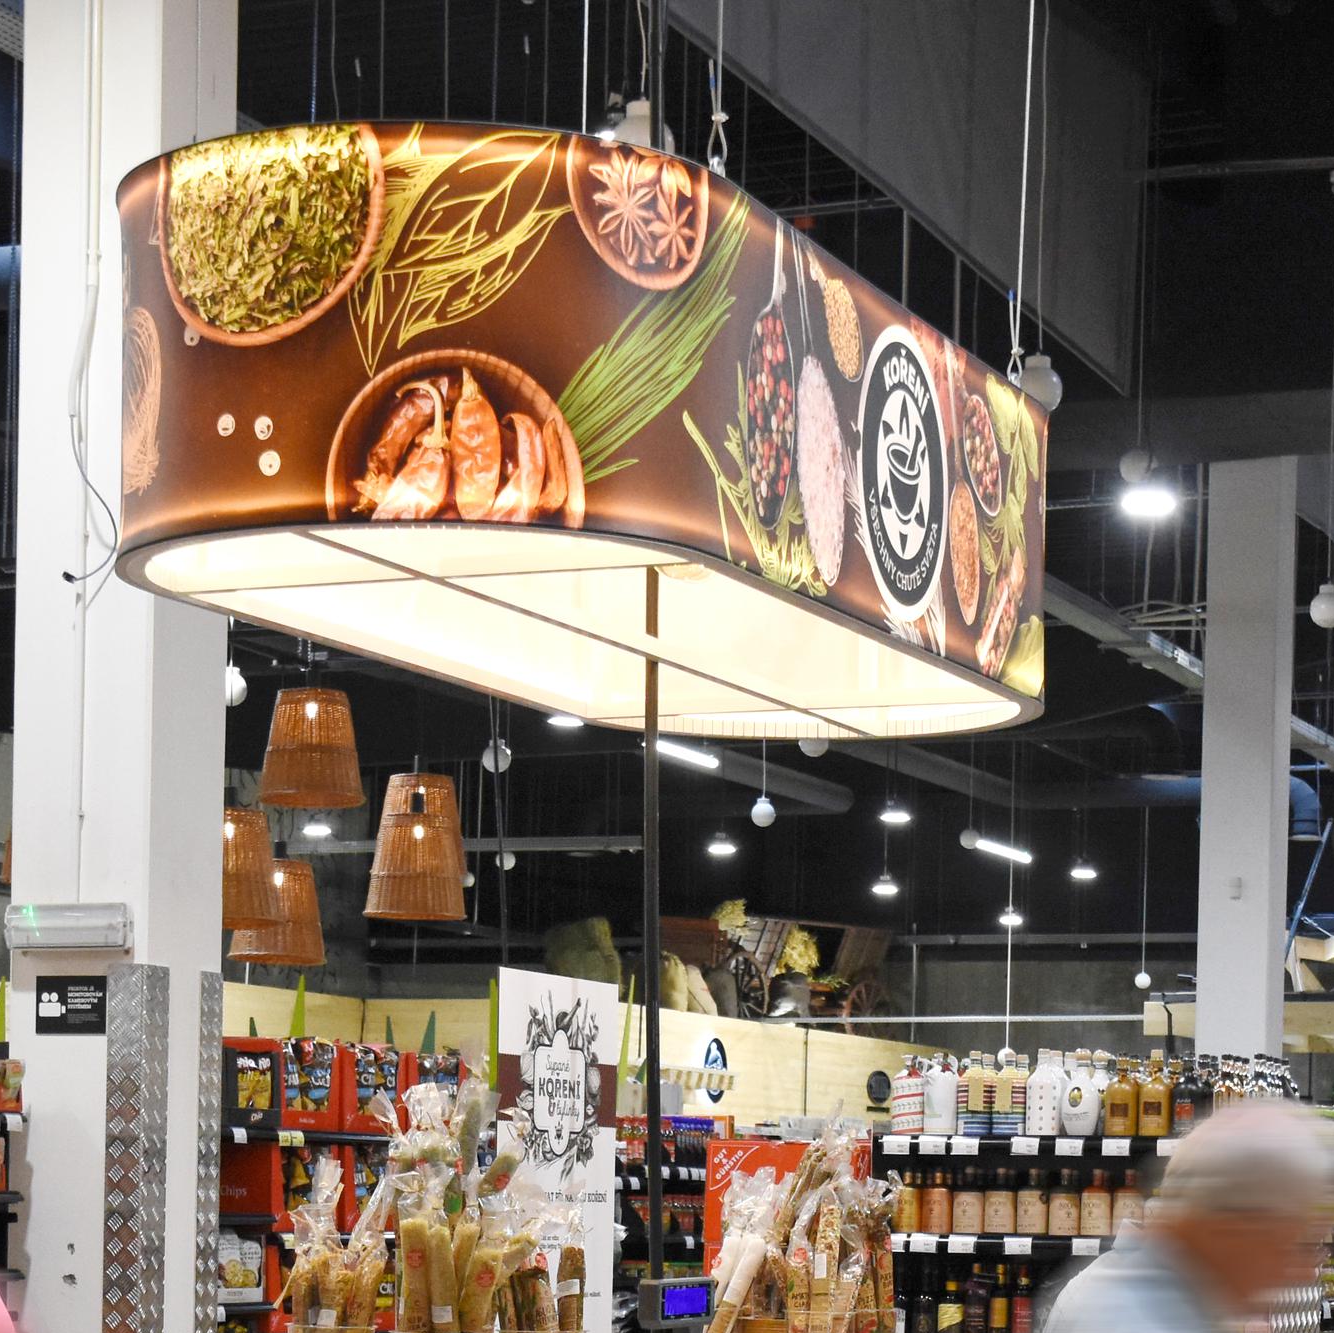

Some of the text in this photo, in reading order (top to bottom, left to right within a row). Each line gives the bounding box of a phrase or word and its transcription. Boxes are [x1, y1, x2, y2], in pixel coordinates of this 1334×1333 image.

[882, 349, 931, 417] KOŘENÍ
[868, 487, 939, 592] VŠECHNY CHUTĚ SVĚTA
[538, 1073, 581, 1099] KOŘENÍ
